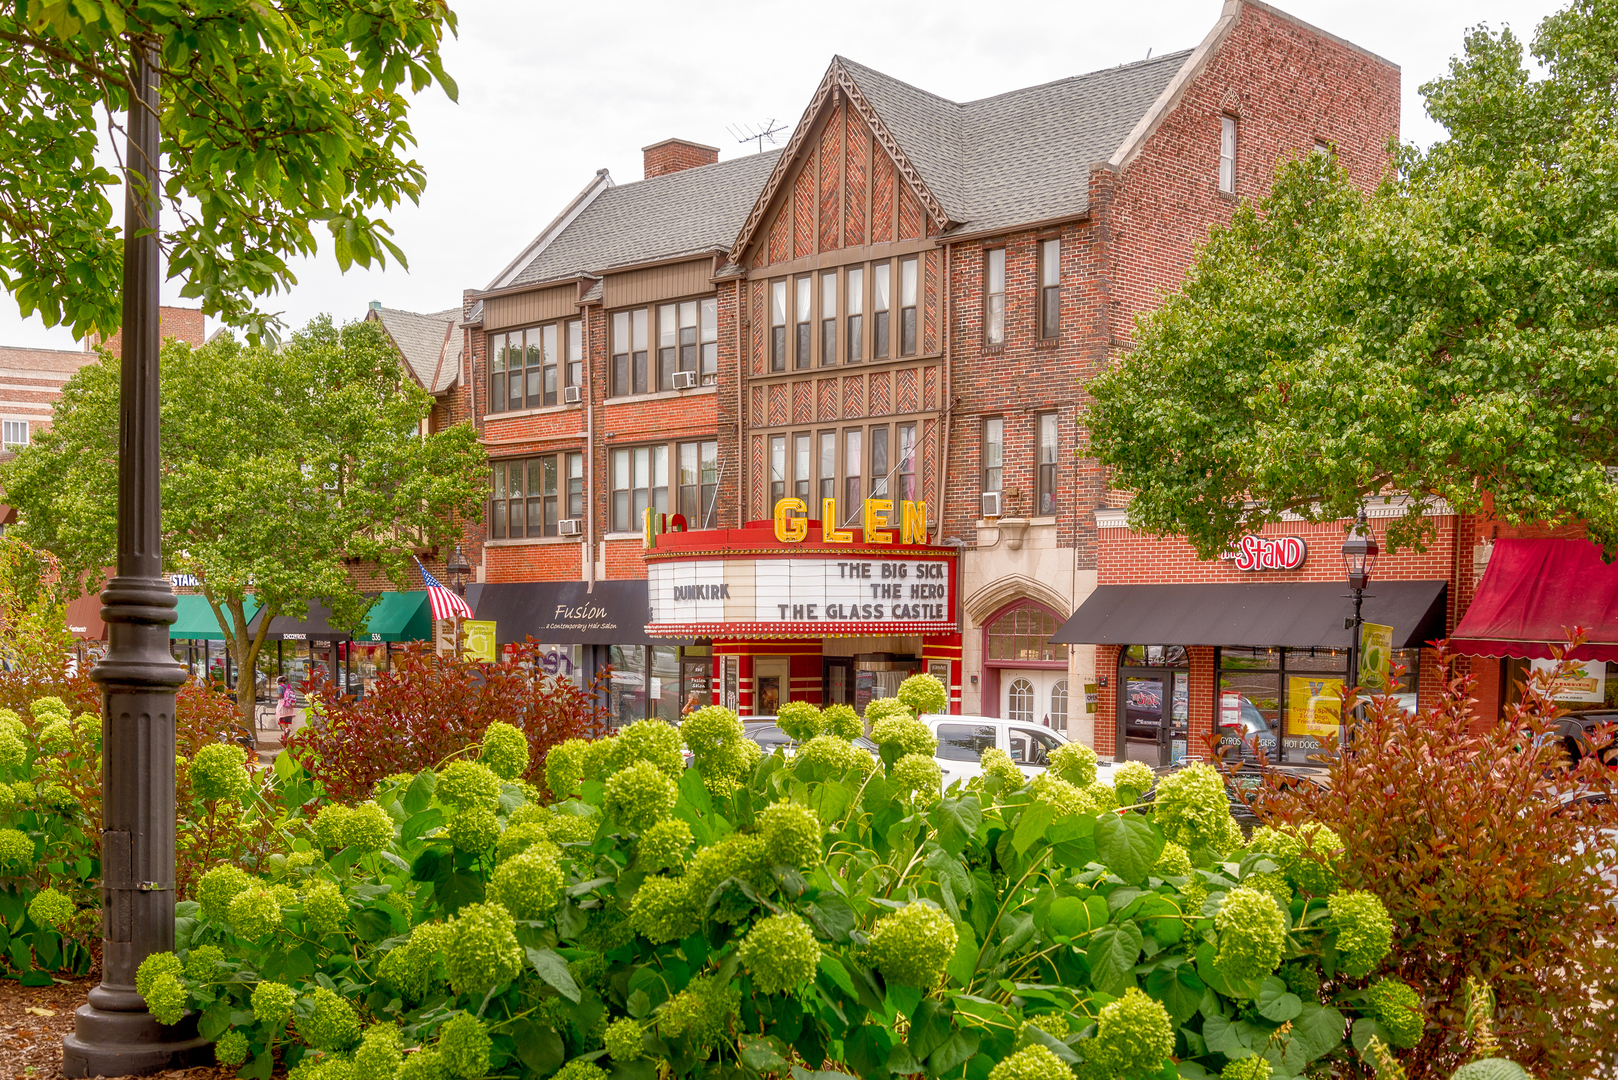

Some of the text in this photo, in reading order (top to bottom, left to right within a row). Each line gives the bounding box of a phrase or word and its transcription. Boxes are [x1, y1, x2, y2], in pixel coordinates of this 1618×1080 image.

[774, 497, 927, 544] GLEN
[837, 562, 944, 579] THE BIG SICK
[673, 583, 731, 601] DUNKIRK
[870, 583, 945, 600] THE HERO
[554, 602, 608, 620] Fusion
[777, 604, 944, 620] THE GLASS CASTLE
[550, 622, 587, 632] Contemporary
[371, 633, 382, 641] 536
[1148, 656, 1166, 664] 542
[1292, 706, 1317, 714] Everyday
[1220, 737, 1242, 746] GYROS
[1284, 740, 1319, 750] HOT DOGS
